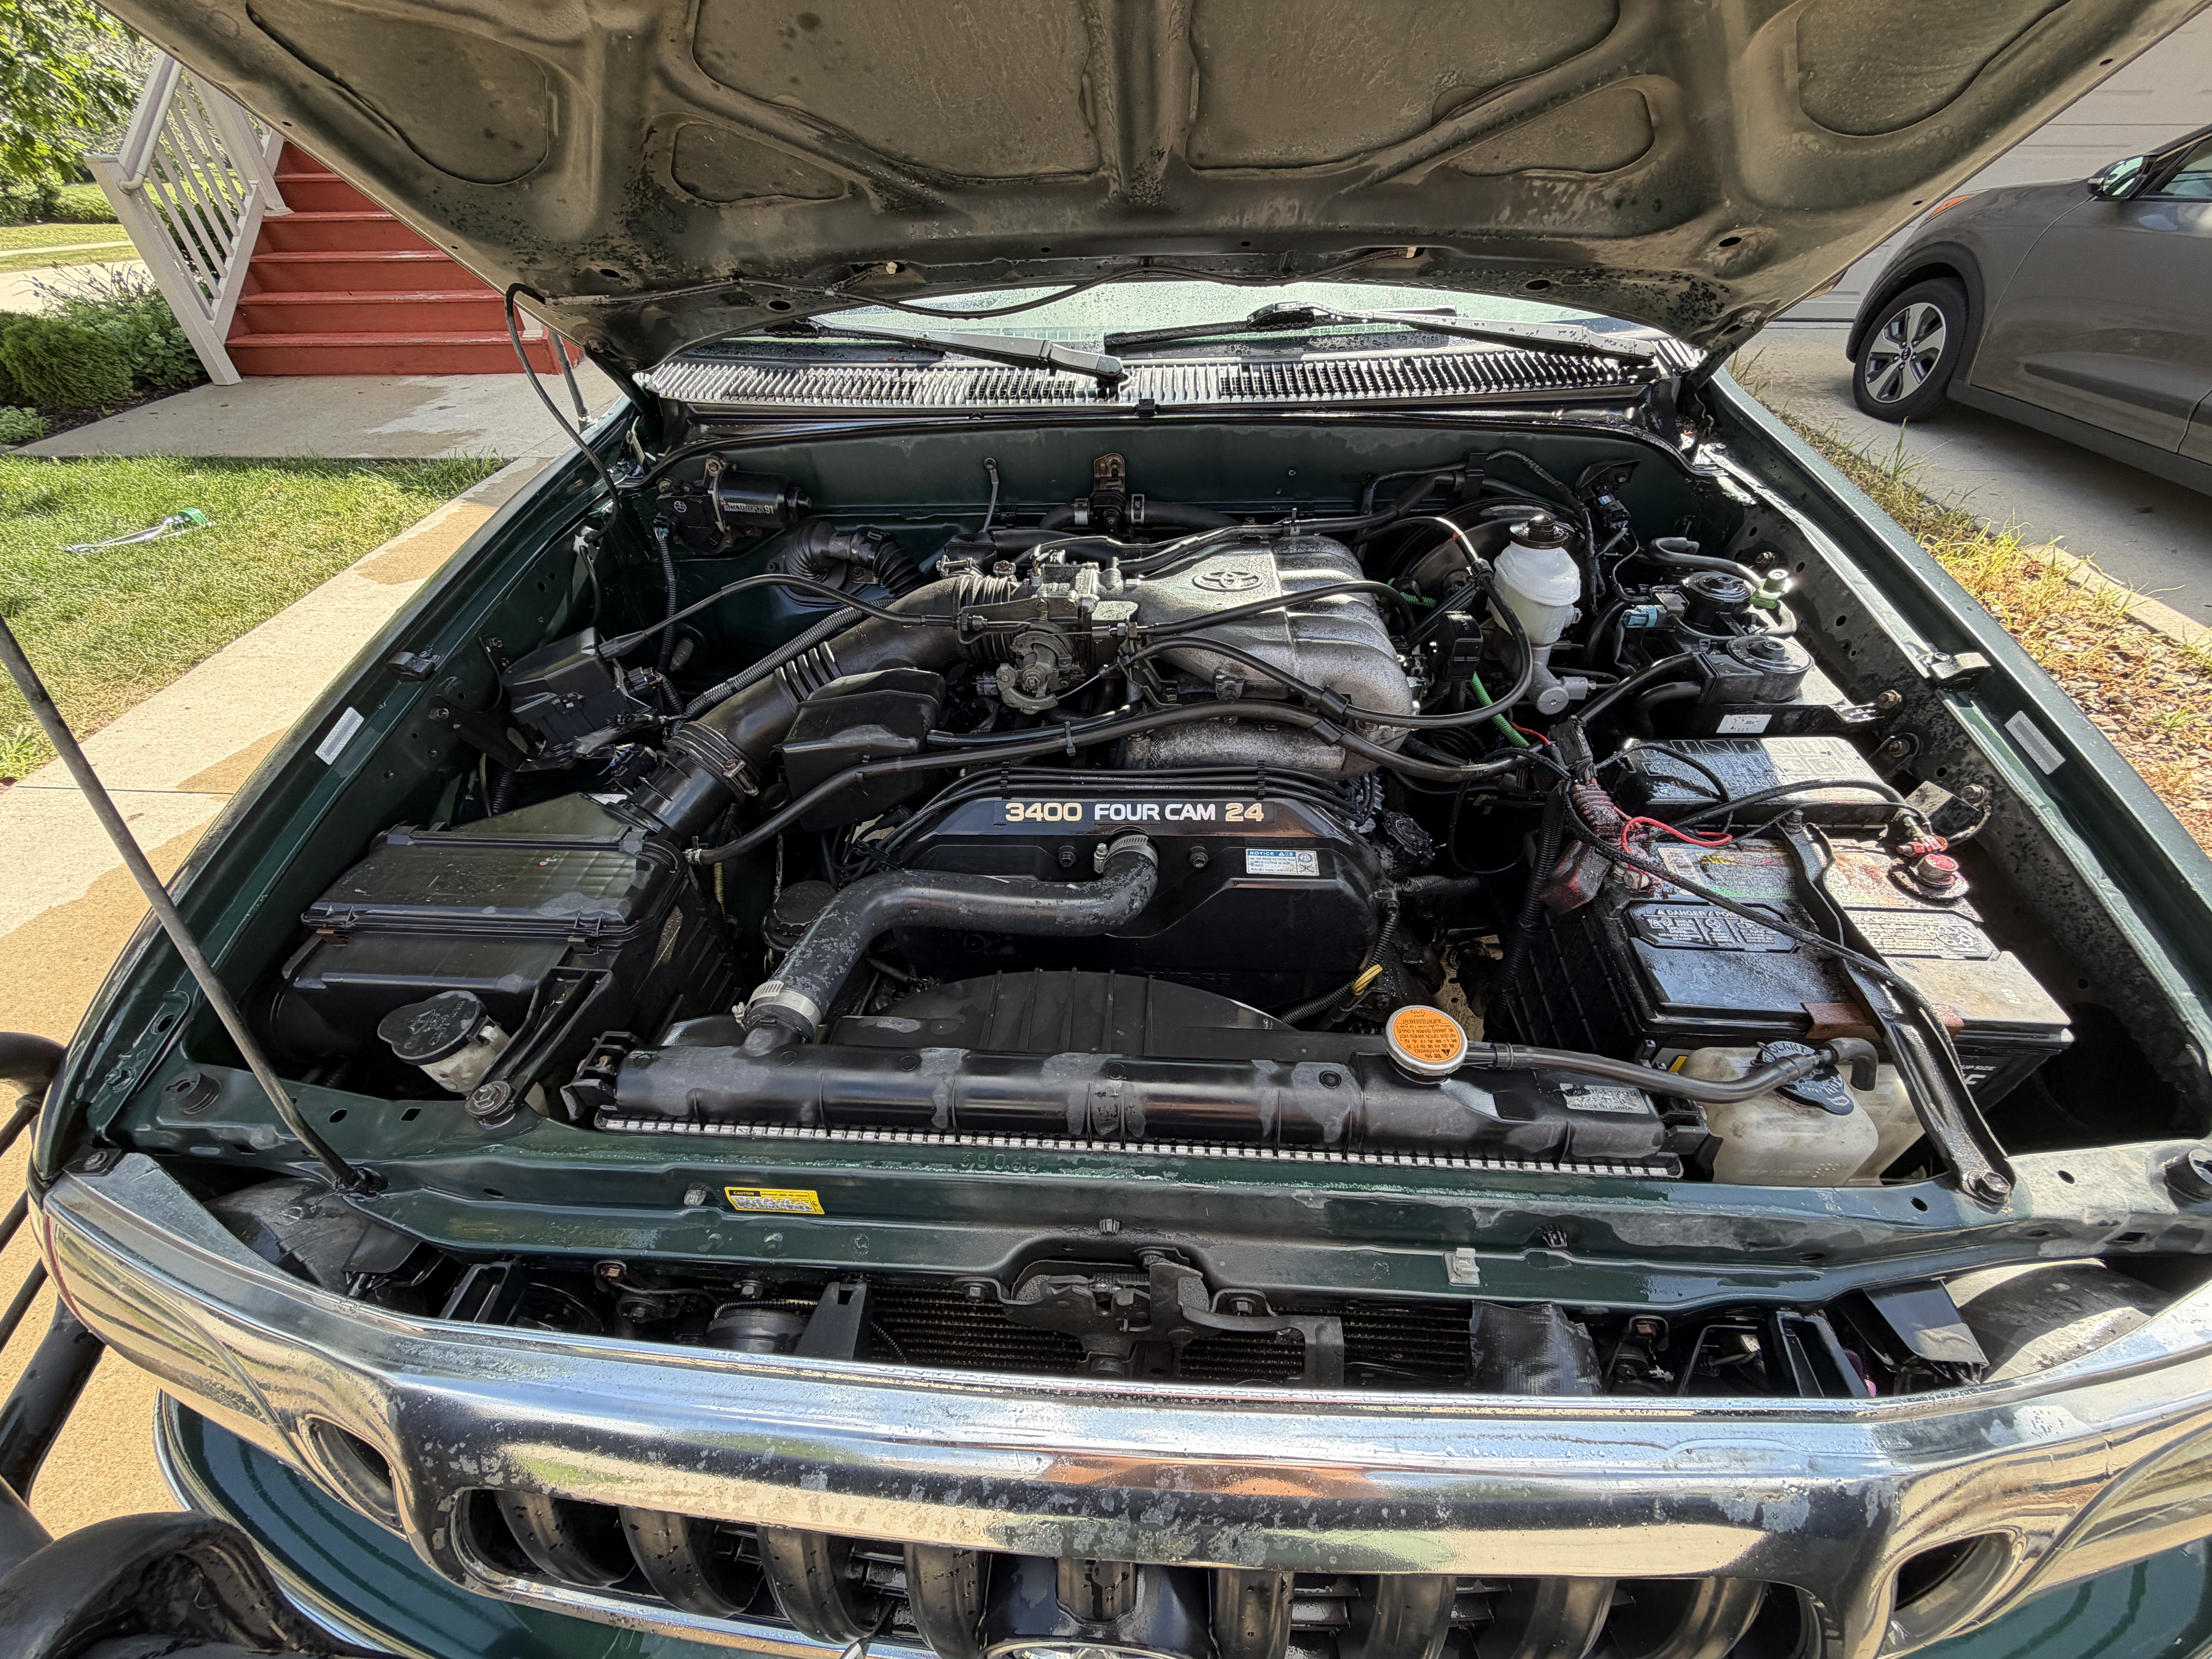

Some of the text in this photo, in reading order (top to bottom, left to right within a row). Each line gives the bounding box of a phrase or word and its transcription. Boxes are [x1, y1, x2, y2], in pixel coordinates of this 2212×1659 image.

[764, 505, 774, 514] 91
[1005, 802, 1264, 822] 3400 FOUR CAM 24
[1764, 1042, 1807, 1063] COOLANT
